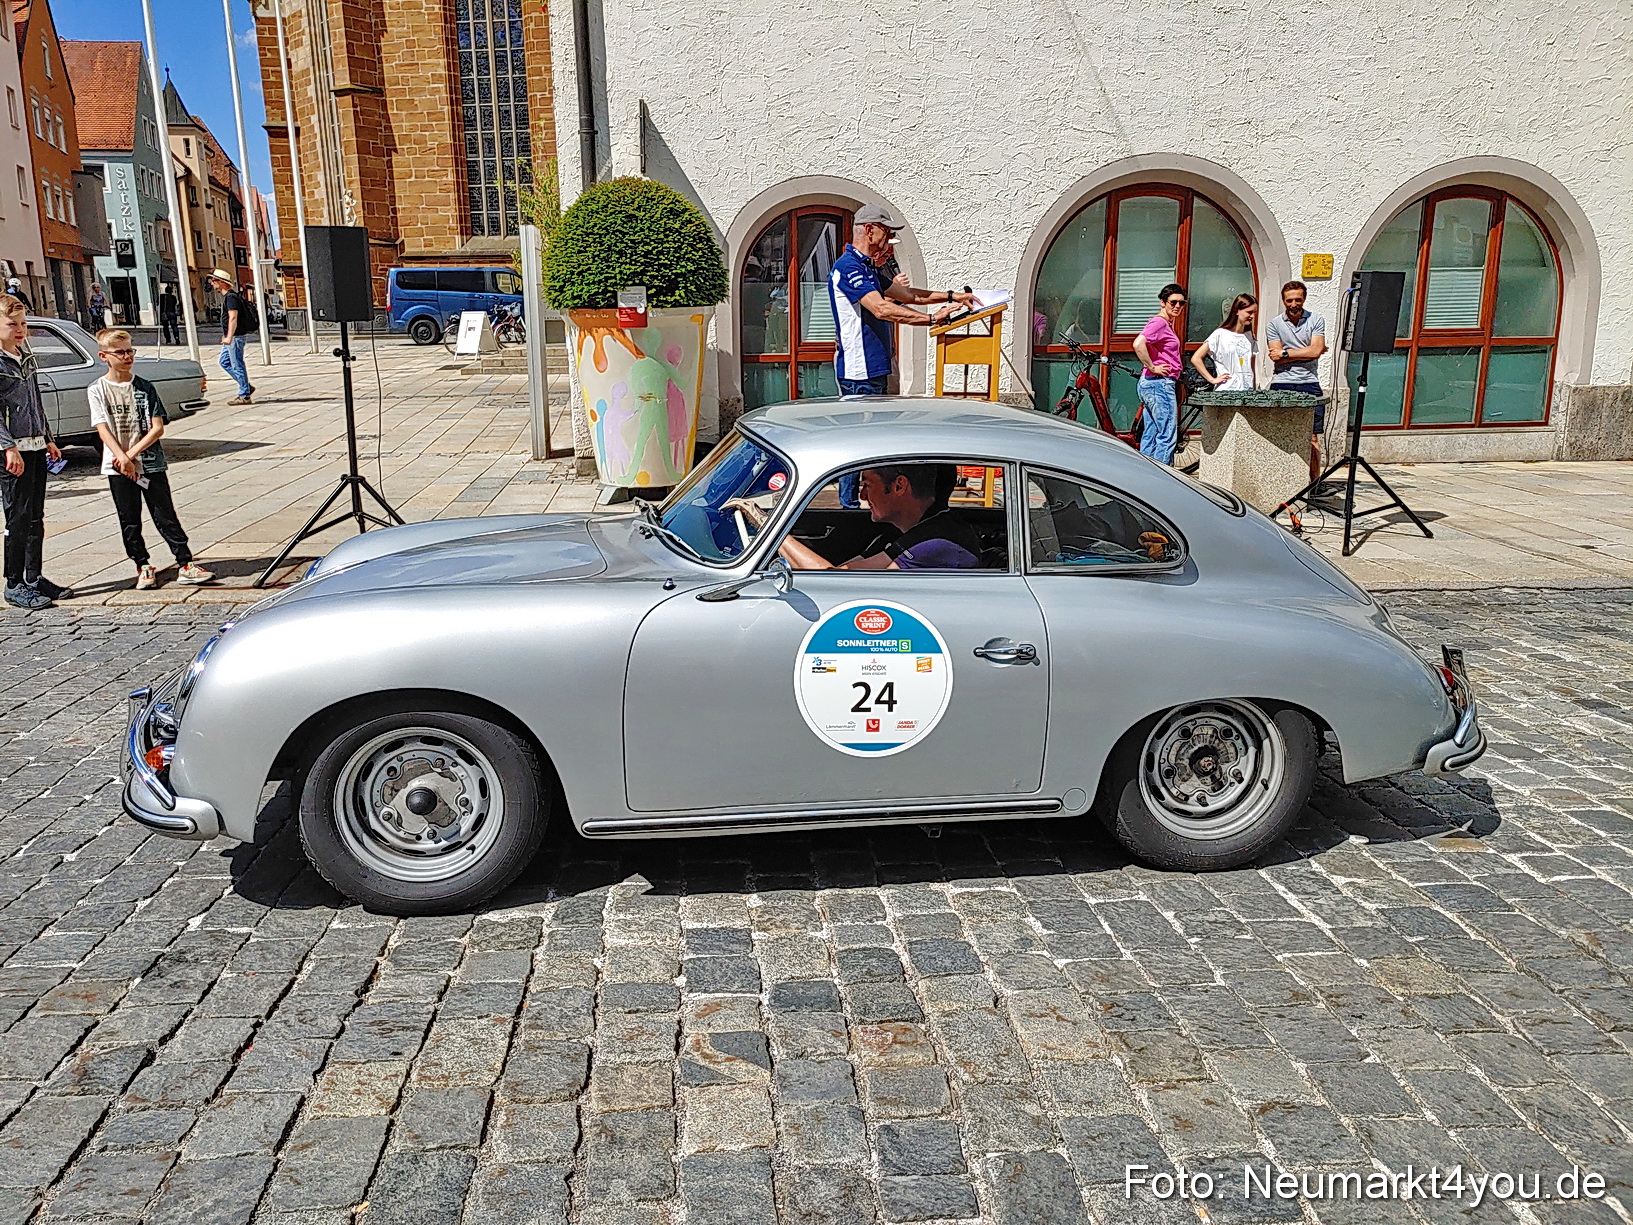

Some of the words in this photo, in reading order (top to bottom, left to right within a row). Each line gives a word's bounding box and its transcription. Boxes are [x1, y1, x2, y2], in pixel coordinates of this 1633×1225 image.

[837, 639, 898, 647] SONNLEITNER
[901, 641, 909, 650] S
[861, 664, 887, 672] HISCOX
[851, 681, 898, 713] 24
